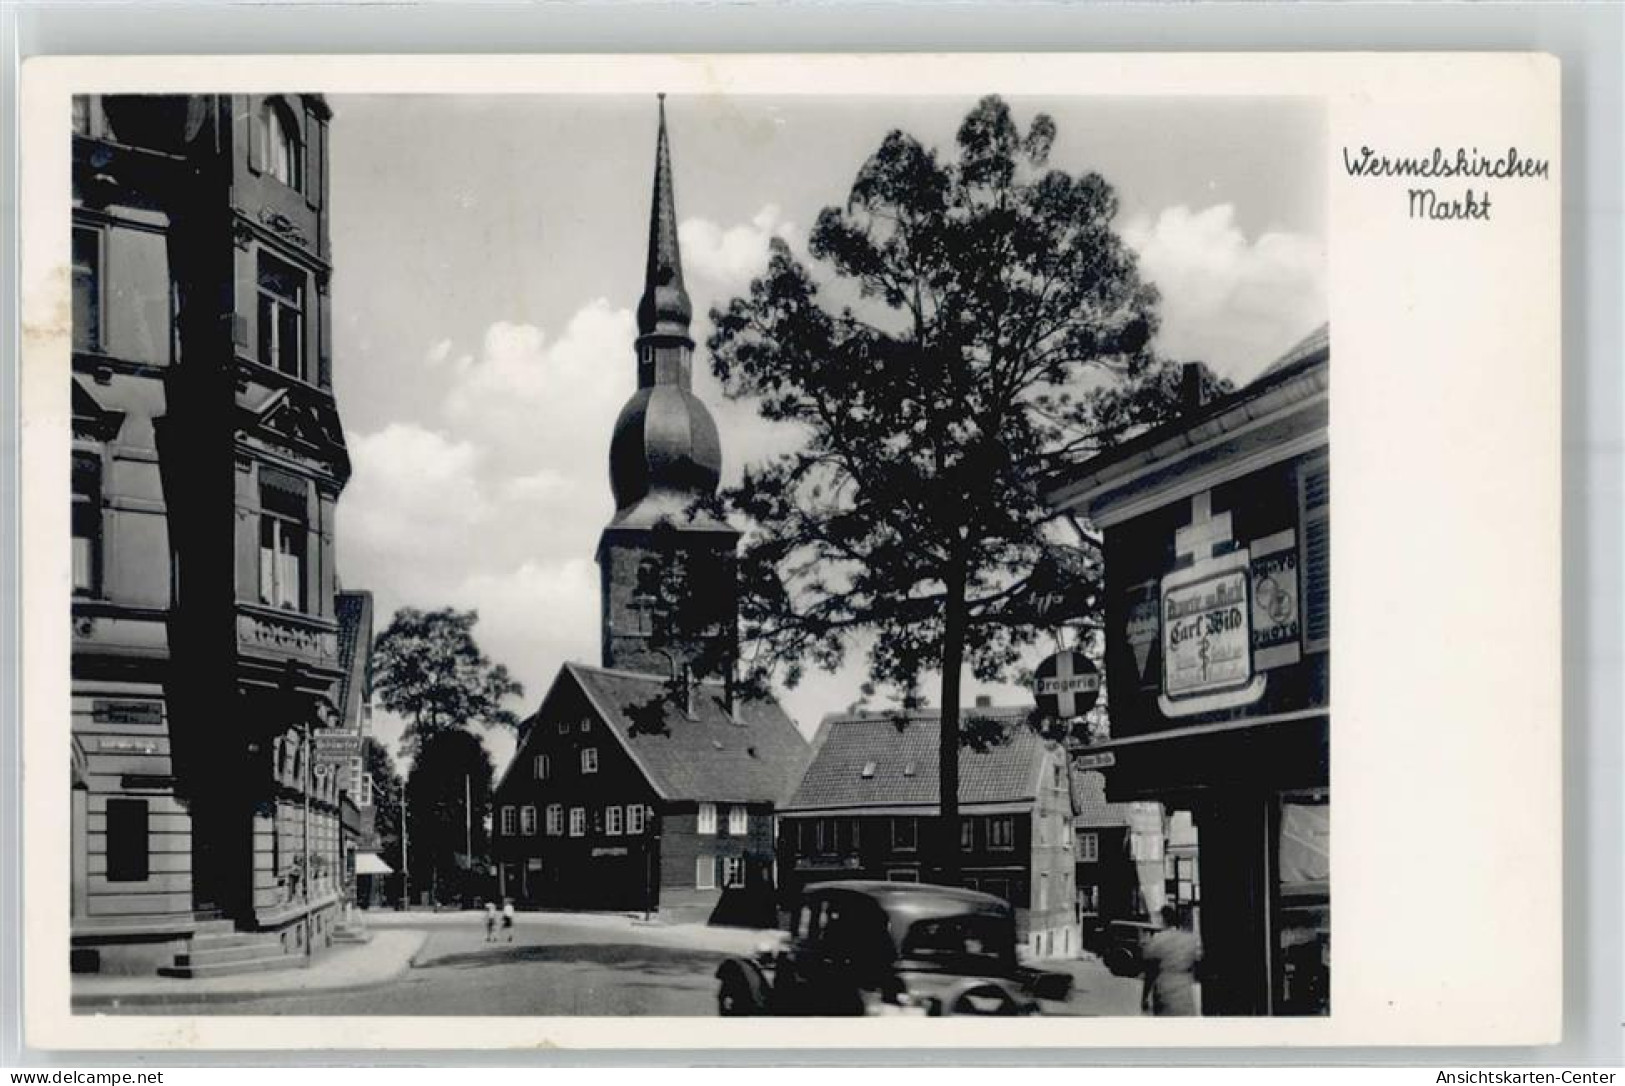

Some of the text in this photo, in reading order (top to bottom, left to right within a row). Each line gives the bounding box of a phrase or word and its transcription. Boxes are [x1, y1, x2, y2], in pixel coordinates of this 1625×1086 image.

[1343, 146, 1549, 180] Wermelskirchen
[1408, 189, 1492, 221] Markt
[1037, 678, 1097, 693] Drogerie
